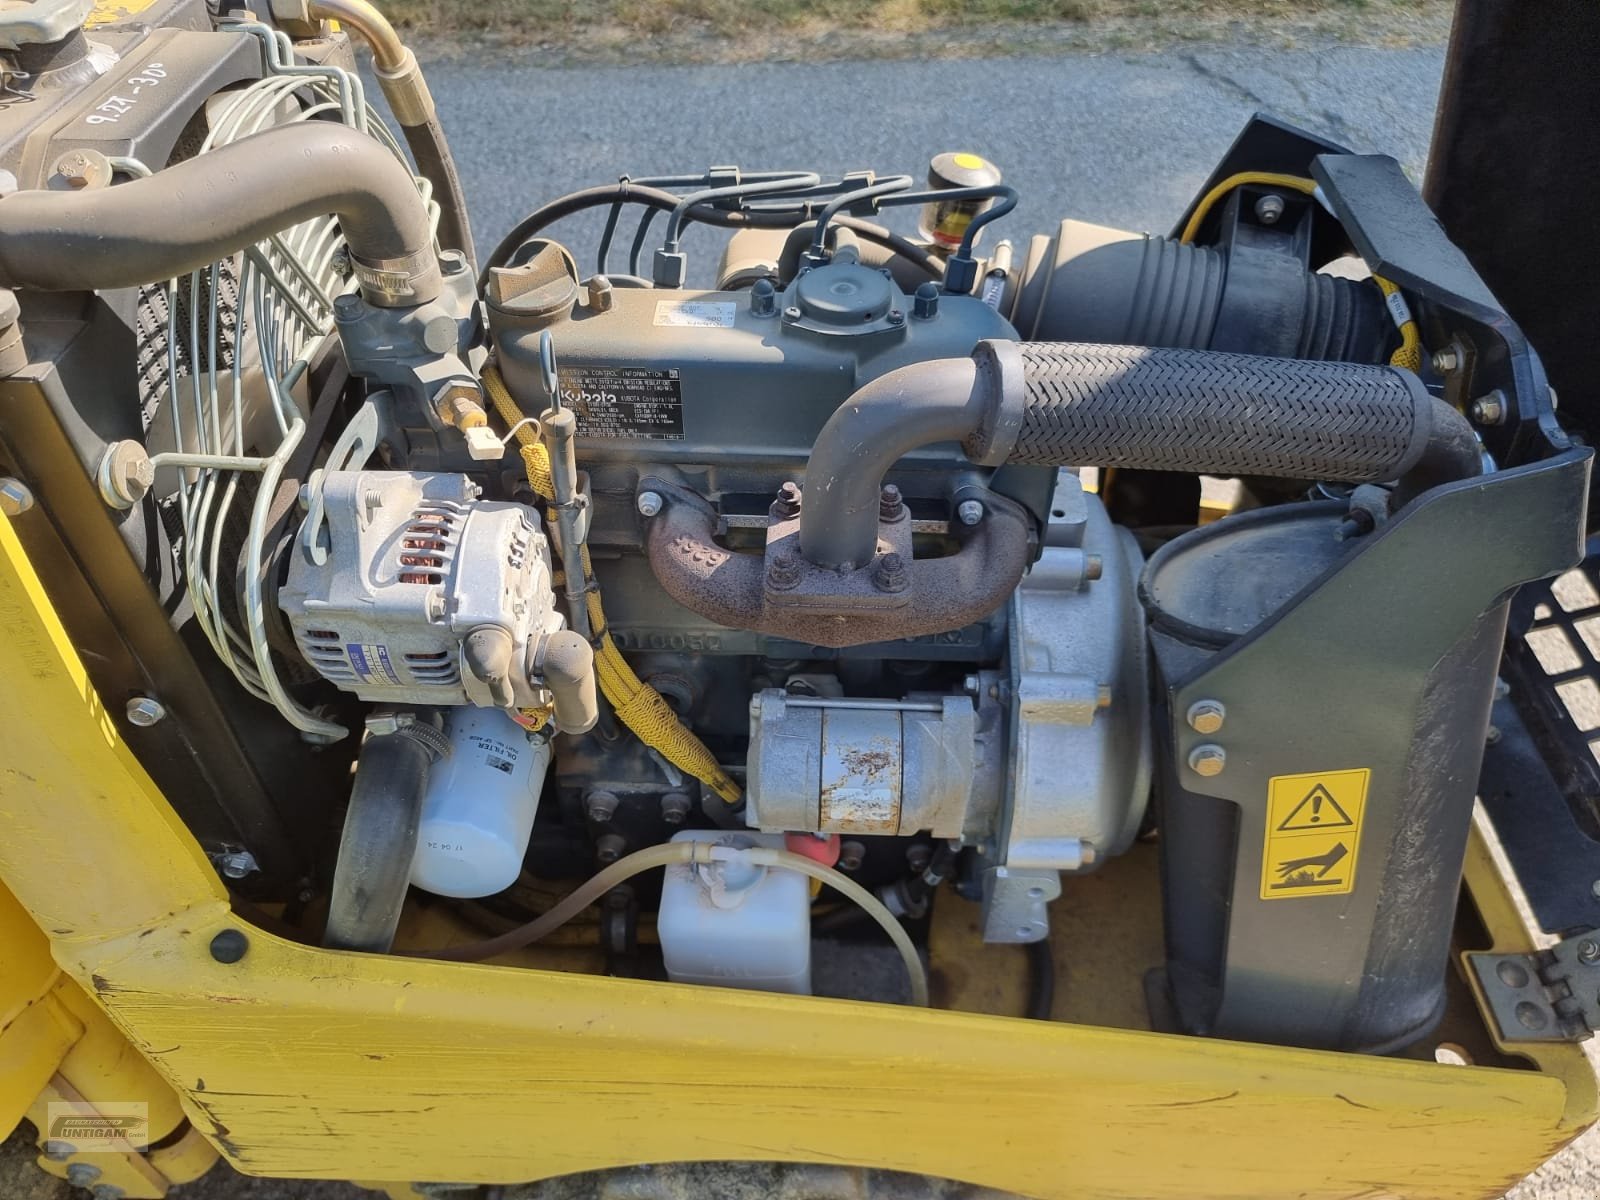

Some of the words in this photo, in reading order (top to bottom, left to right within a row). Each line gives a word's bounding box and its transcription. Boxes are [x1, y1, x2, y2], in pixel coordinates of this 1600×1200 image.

[560, 390, 617, 403] Kubota
[478, 742, 505, 755] FILTER
[506, 750, 517, 760] OIL
